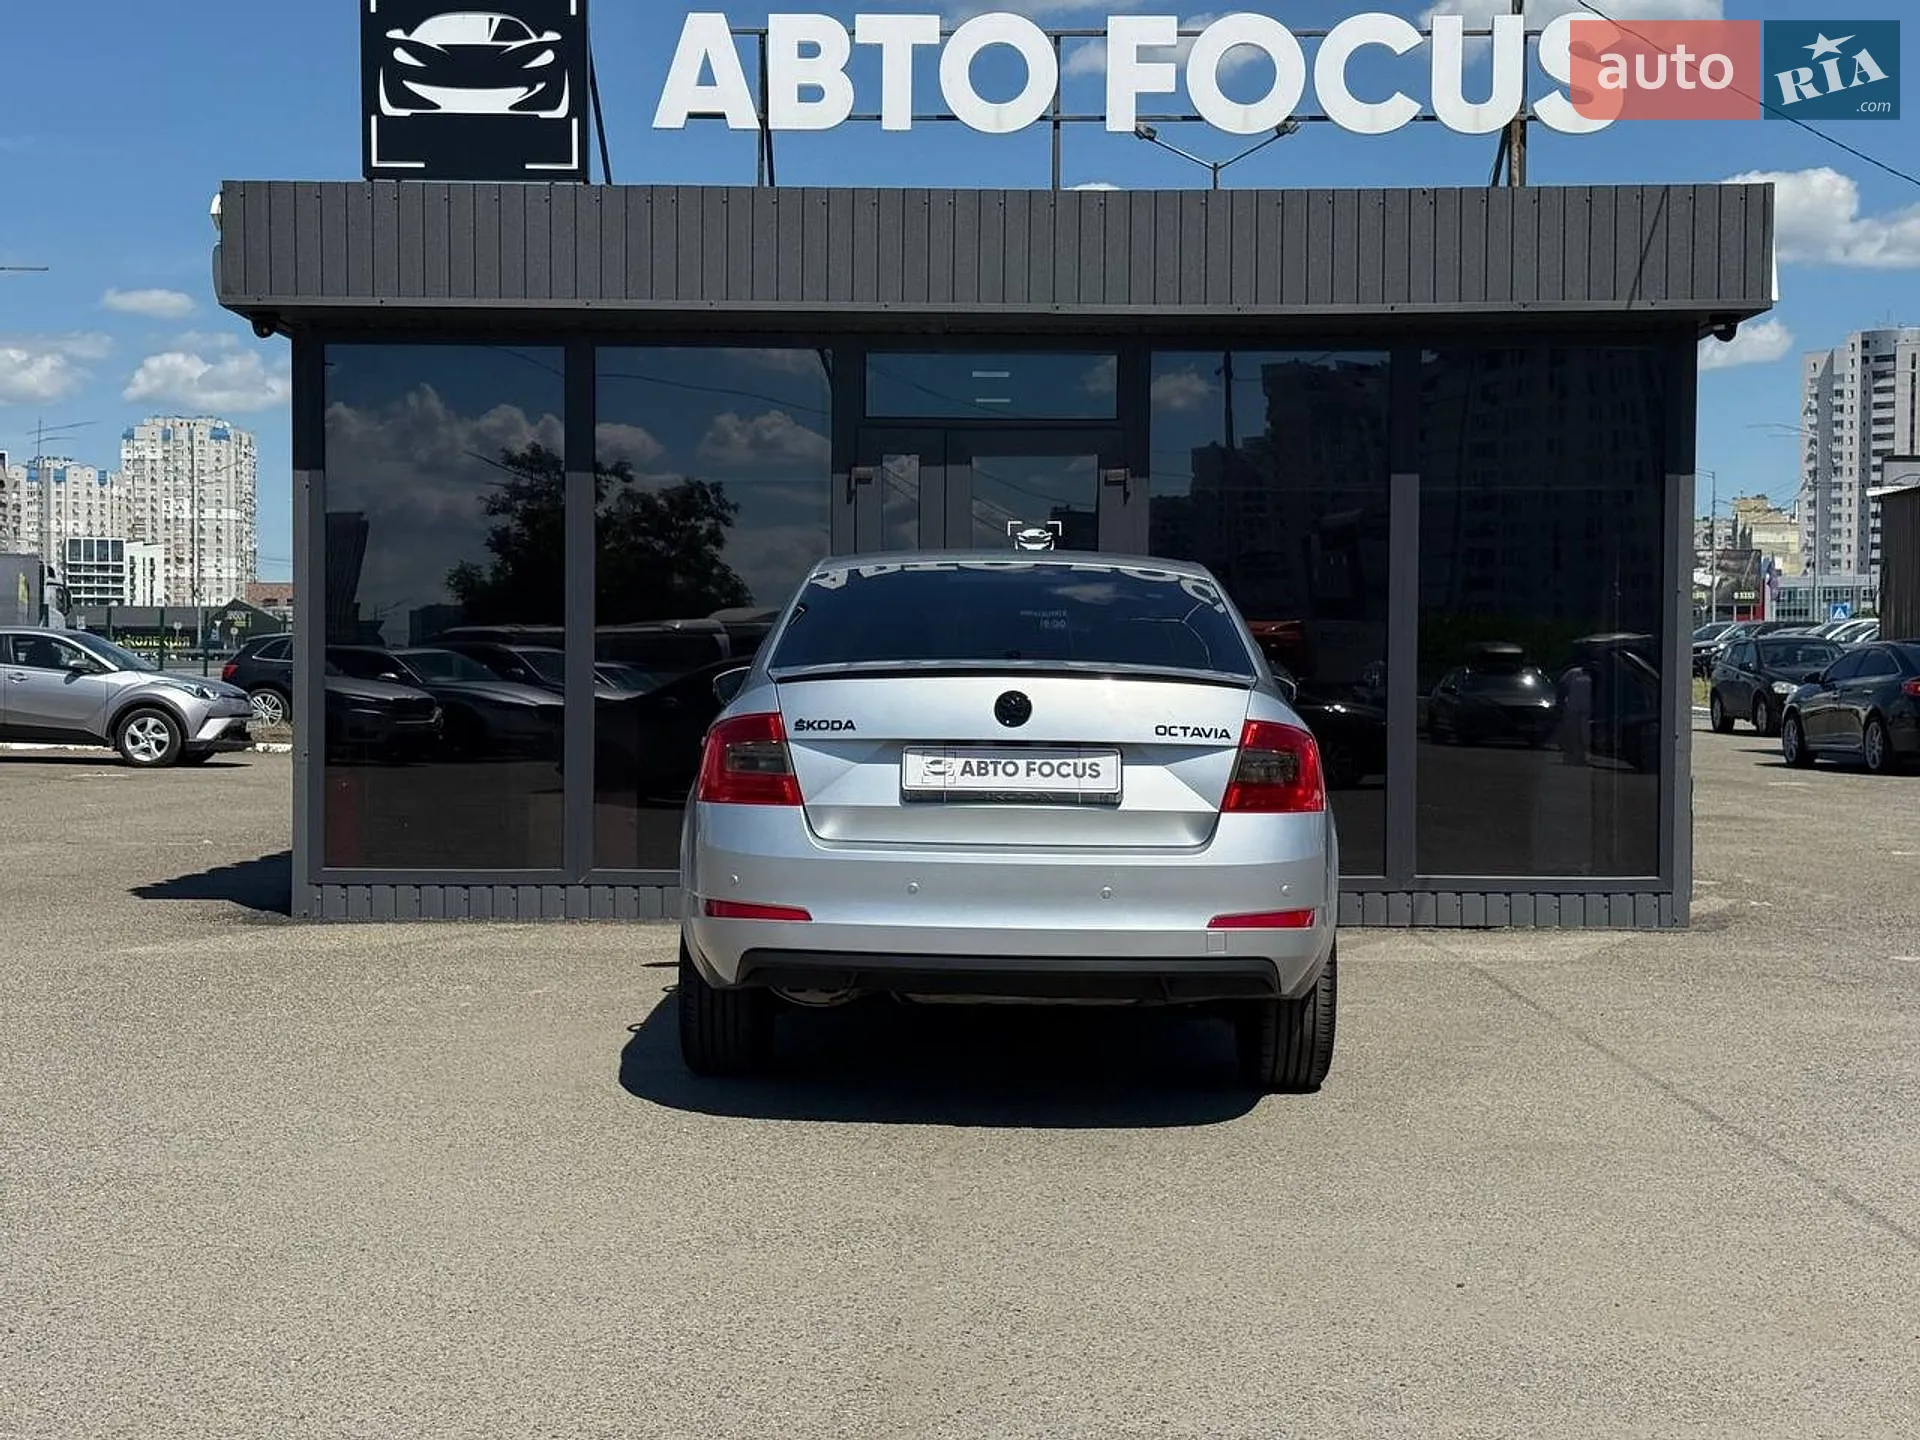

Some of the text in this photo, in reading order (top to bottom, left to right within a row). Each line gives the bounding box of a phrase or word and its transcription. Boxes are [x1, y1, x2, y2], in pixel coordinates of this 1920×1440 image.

[652, 12, 1626, 135] АВТО FOCUS
[1154, 724, 1232, 740] OCTAVIA
[960, 760, 1101, 779] АВТО FOCUS
